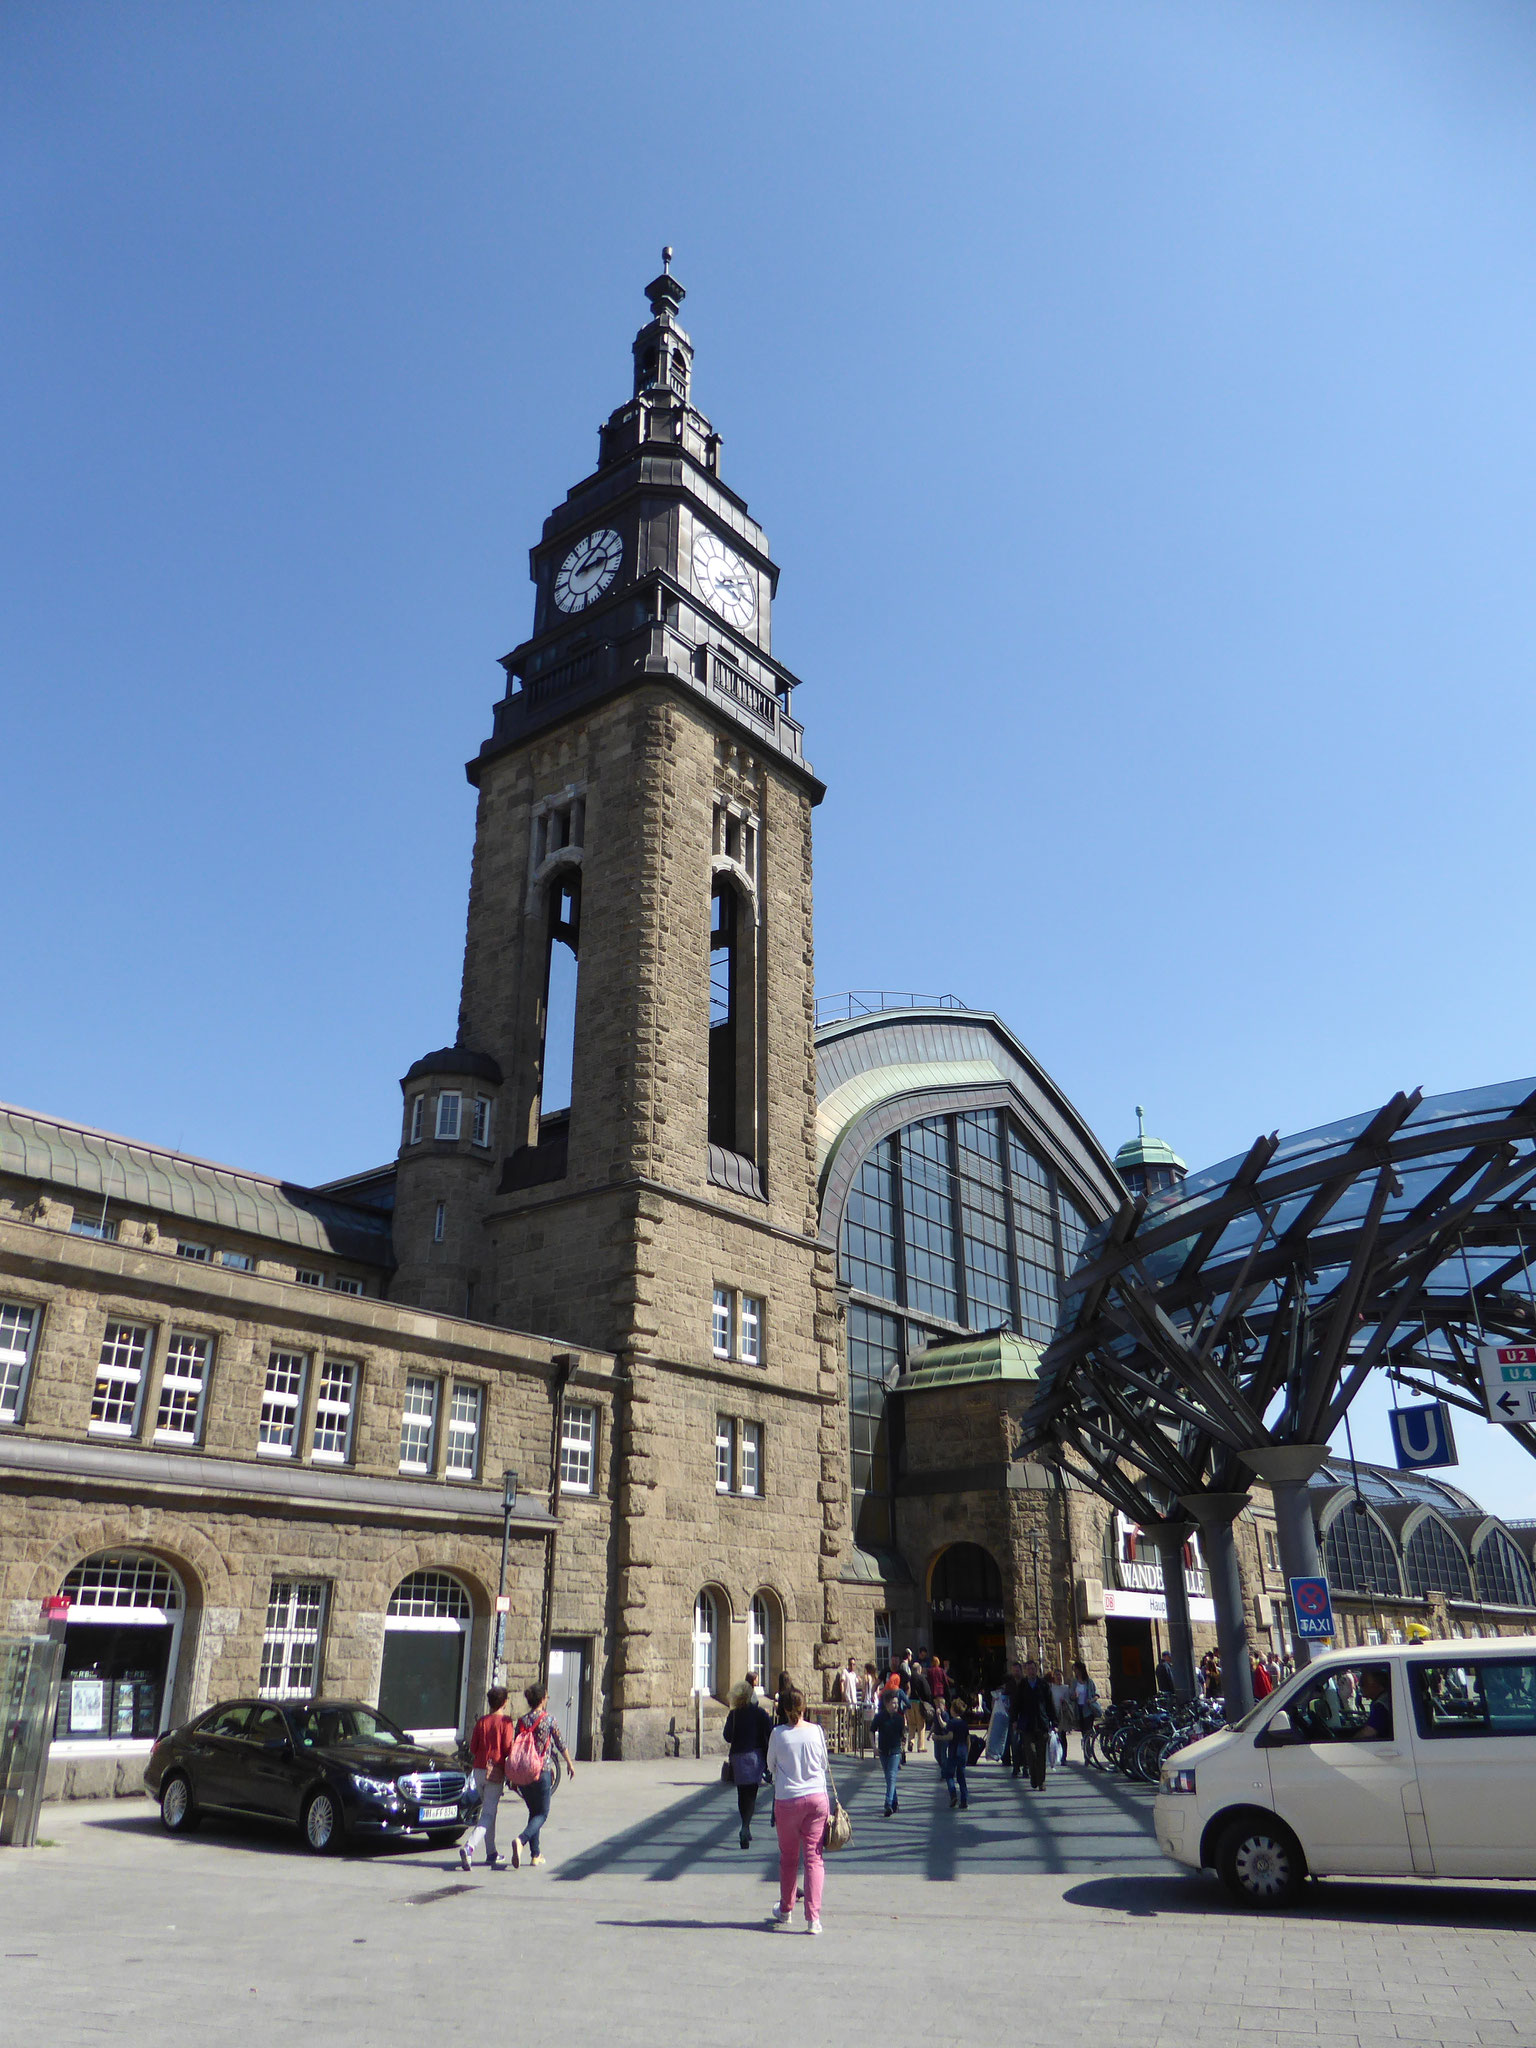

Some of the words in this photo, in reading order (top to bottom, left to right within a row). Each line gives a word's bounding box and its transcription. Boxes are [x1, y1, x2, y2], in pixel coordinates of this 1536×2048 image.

[1506, 1350, 1528, 1361] U2
[1509, 1368, 1532, 1379] U4
[1397, 1410, 1438, 1461] U
[1120, 1562, 1205, 1594] WANDELLE
[1105, 1595, 1114, 1608] DB
[1300, 1618, 1330, 1631] TAXI
